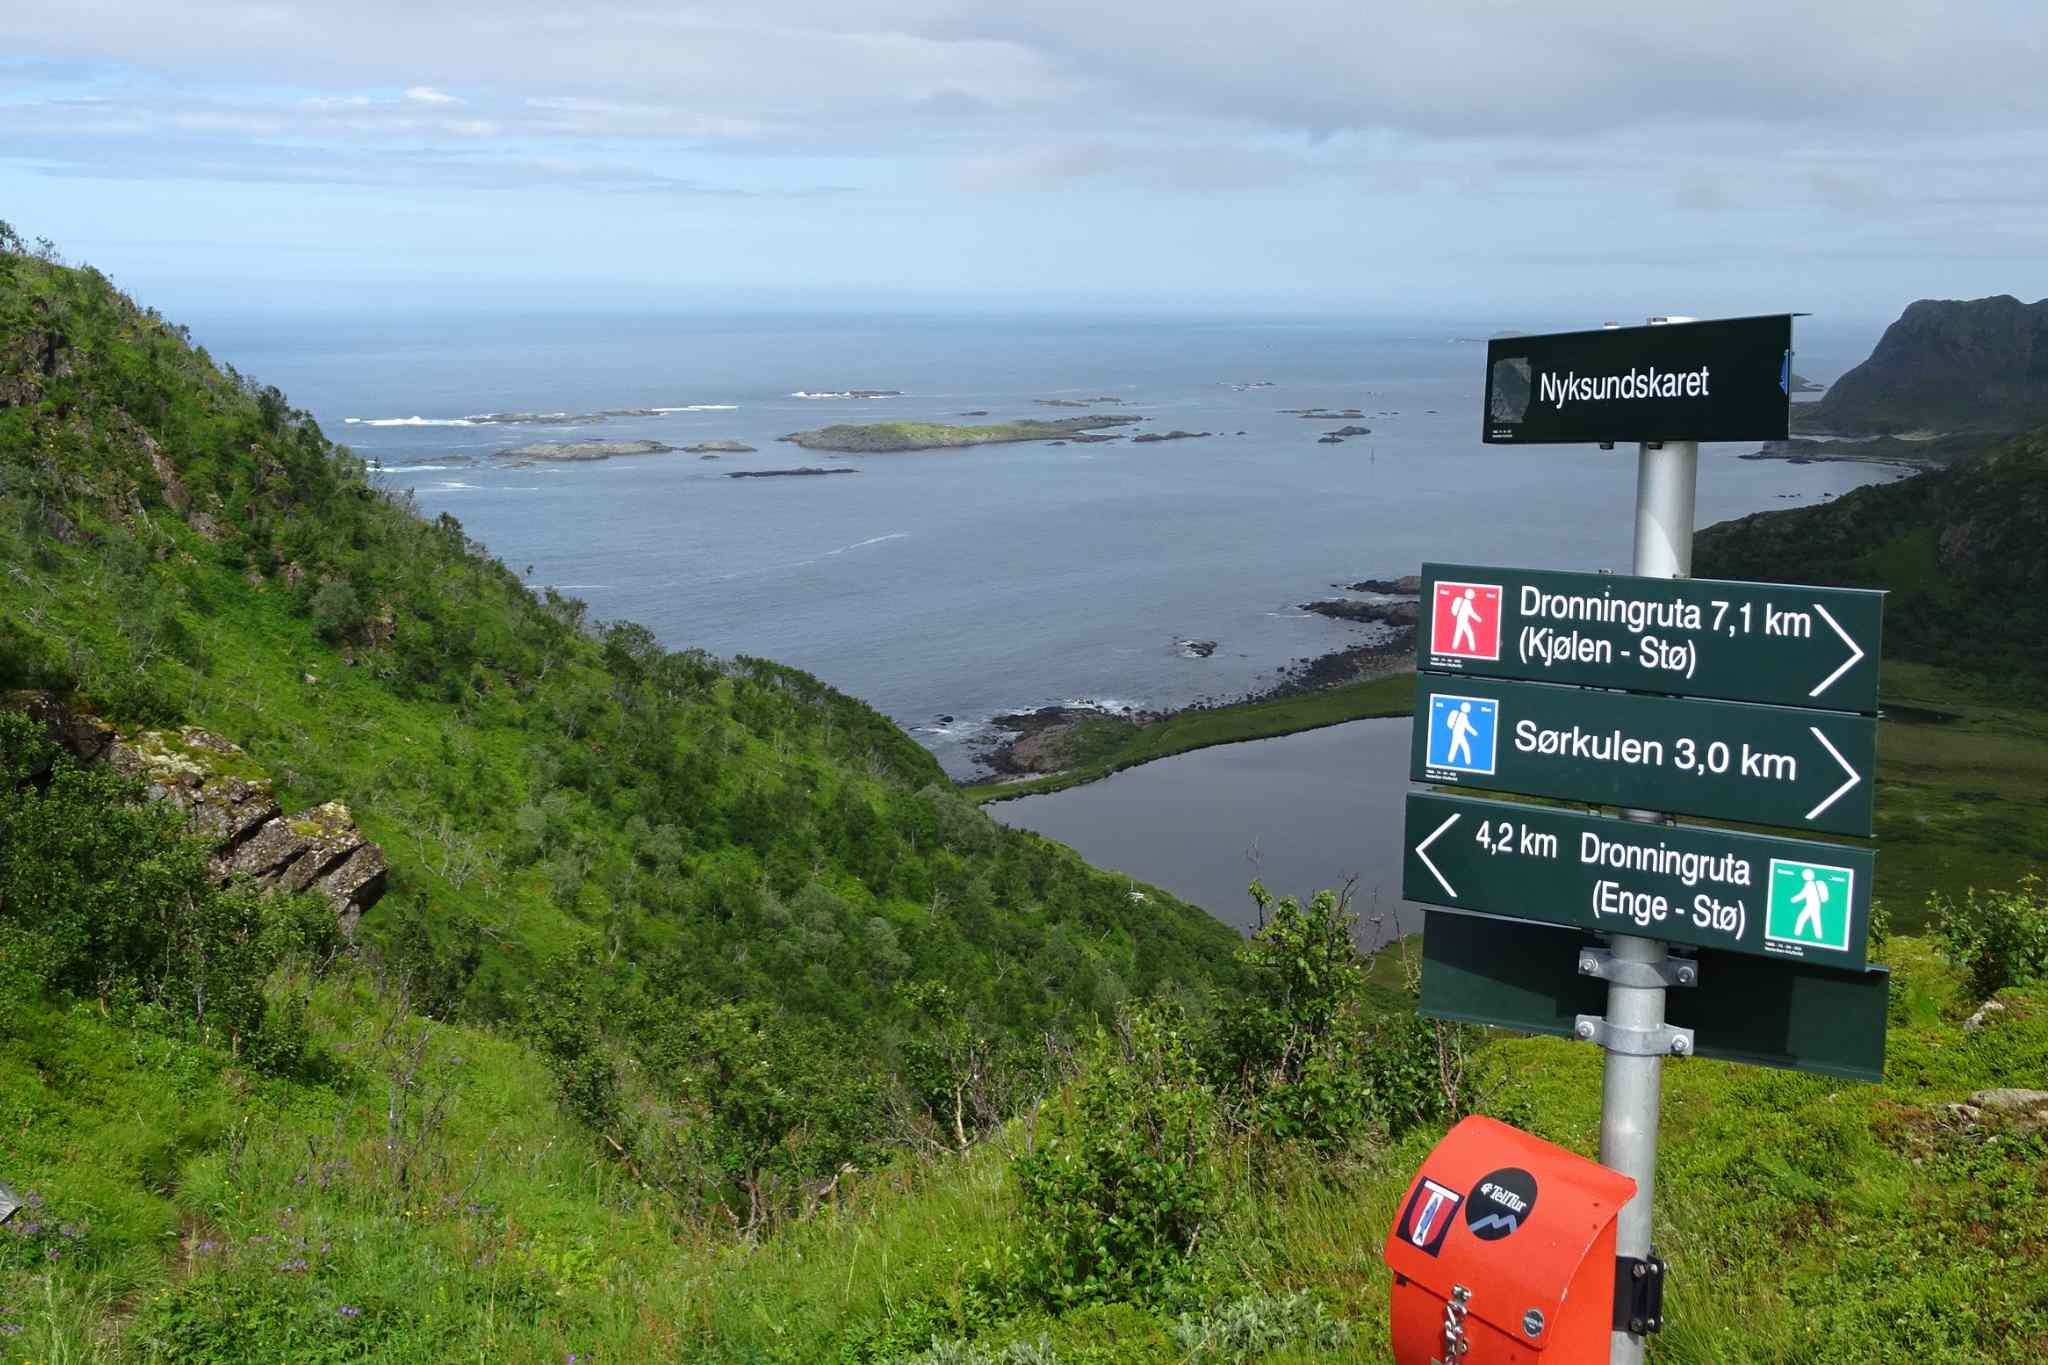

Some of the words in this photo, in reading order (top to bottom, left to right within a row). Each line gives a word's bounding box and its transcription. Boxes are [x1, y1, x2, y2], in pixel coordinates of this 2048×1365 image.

[1540, 365, 1710, 409] Nyksundskaret
[1520, 585, 1702, 634] Dronningruta
[1710, 600, 1752, 638] 7,1
[1765, 602, 1811, 638] km
[1519, 625, 1612, 667] (Kjølen
[1639, 635, 1697, 680] Stø)
[1514, 719, 1664, 766] Sørkulen
[1673, 737, 1730, 777] 3,0
[1741, 743, 1797, 781] km
[1475, 820, 1514, 856] 4,2
[1520, 823, 1558, 859] km
[1580, 831, 1751, 887] Dronningruta
[1592, 879, 1668, 927] (Enge
[1692, 893, 1746, 941] Stø)
